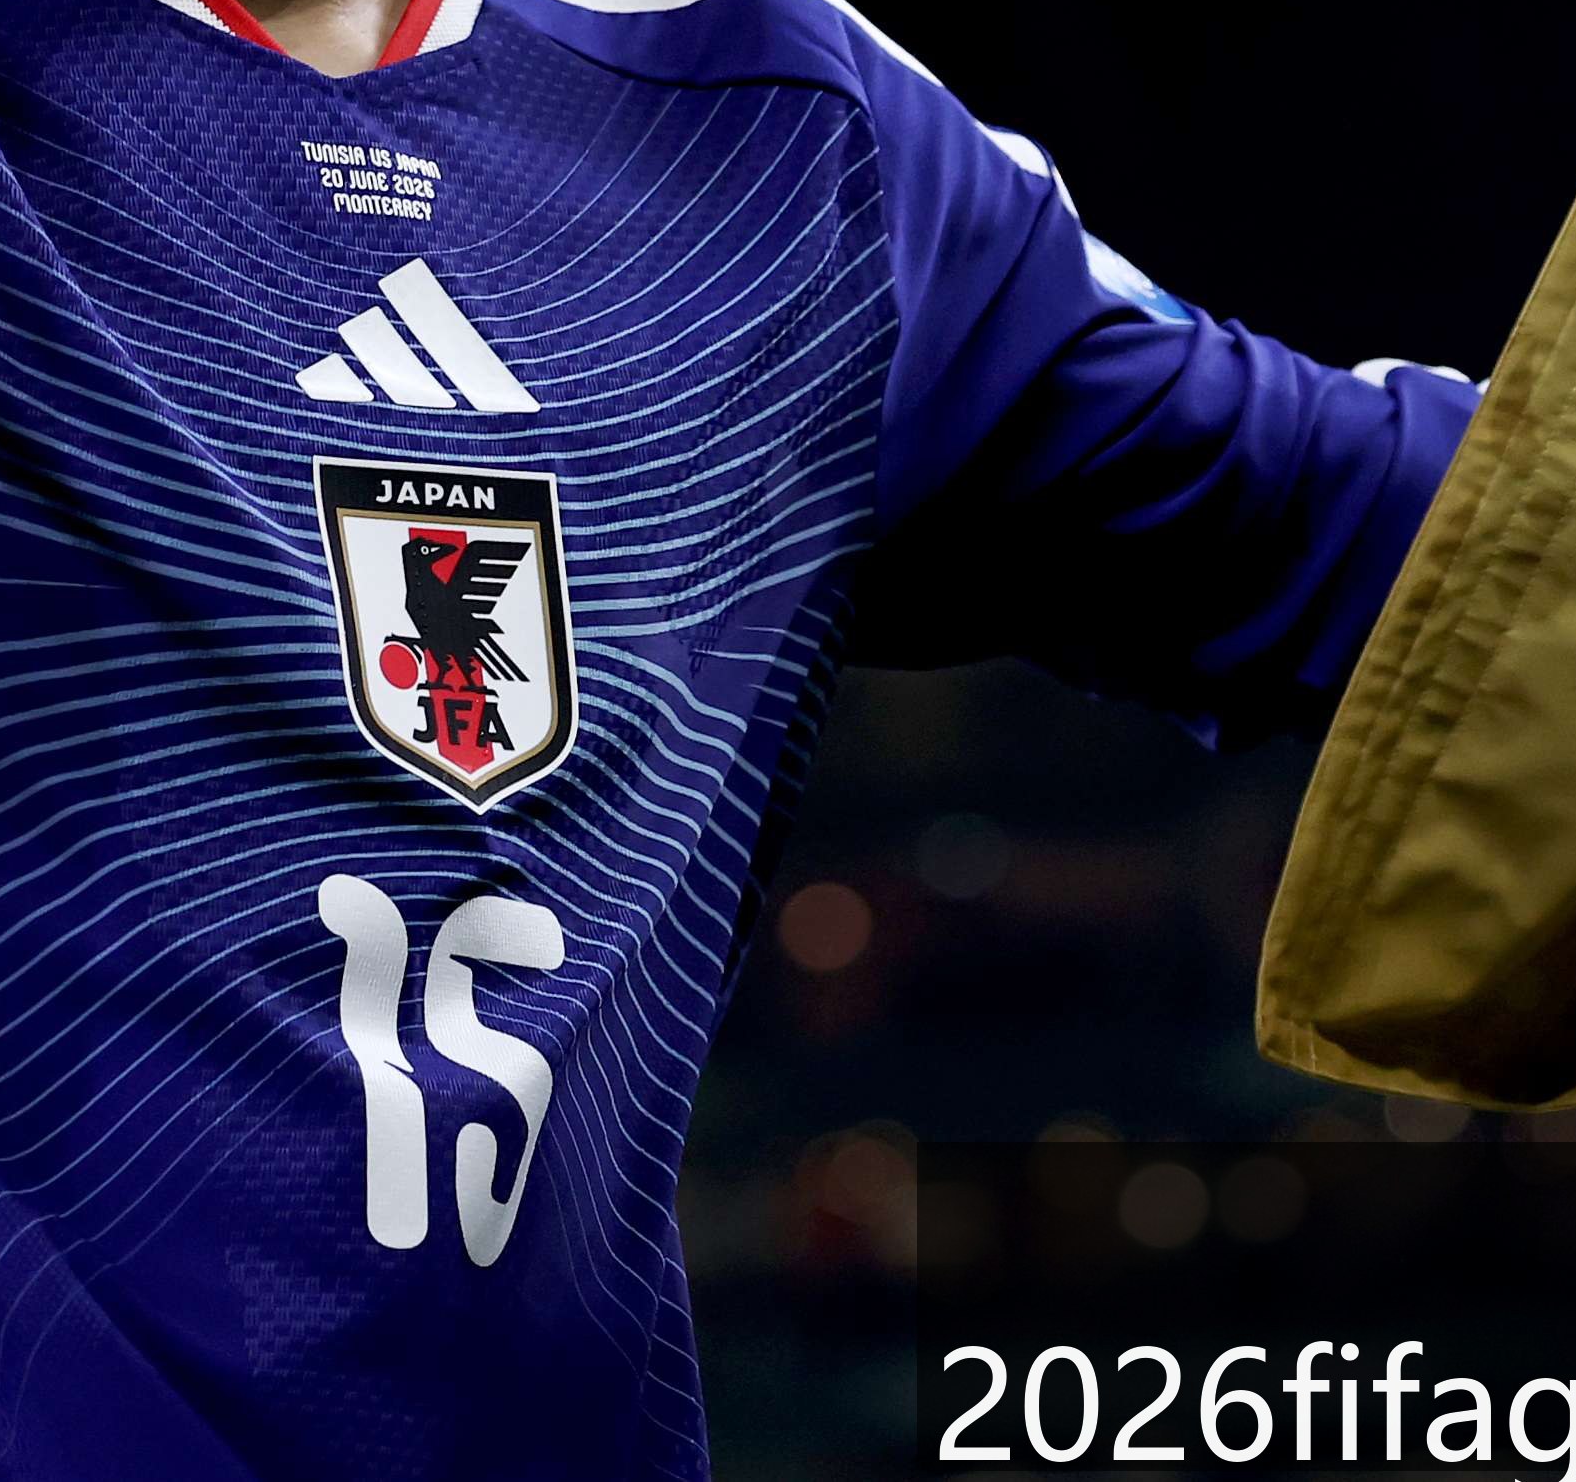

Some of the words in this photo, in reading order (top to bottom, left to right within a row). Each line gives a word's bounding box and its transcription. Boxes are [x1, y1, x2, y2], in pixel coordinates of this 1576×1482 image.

[300, 141, 367, 166] TUNISIA
[395, 152, 442, 180] JAPAN
[320, 167, 344, 188] 20
[349, 169, 389, 192] JUNE
[392, 174, 435, 199] 2026
[333, 192, 432, 221] MONTERREY
[375, 479, 496, 511] JAPAN
[412, 695, 515, 751] JFA
[318, 873, 566, 1267] 15
